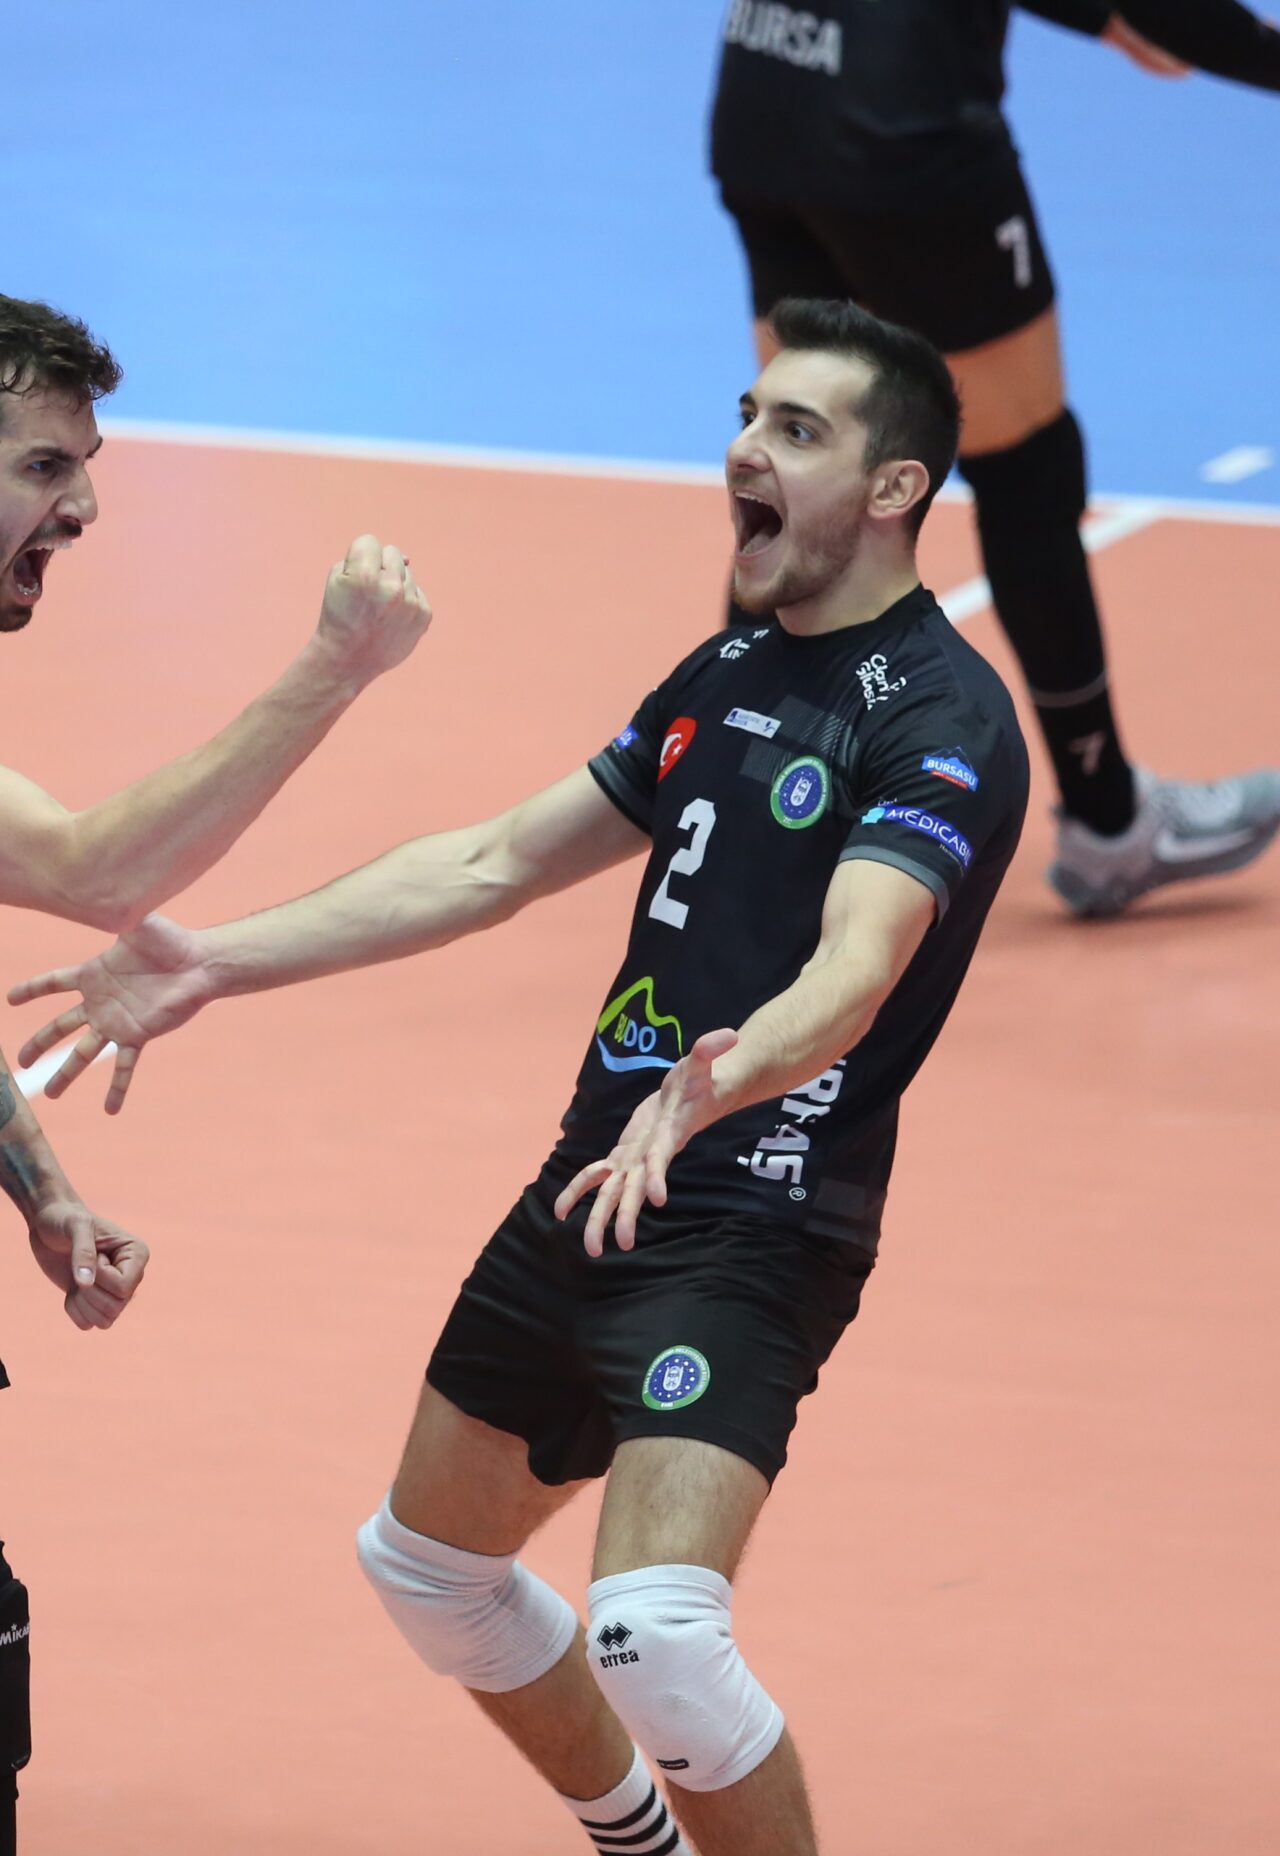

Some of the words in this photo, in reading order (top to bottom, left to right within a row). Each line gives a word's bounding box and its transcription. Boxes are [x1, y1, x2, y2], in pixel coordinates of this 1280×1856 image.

[723, 0, 842, 76] BURSA
[926, 759, 977, 787] BURSASU
[647, 797, 717, 930] 2
